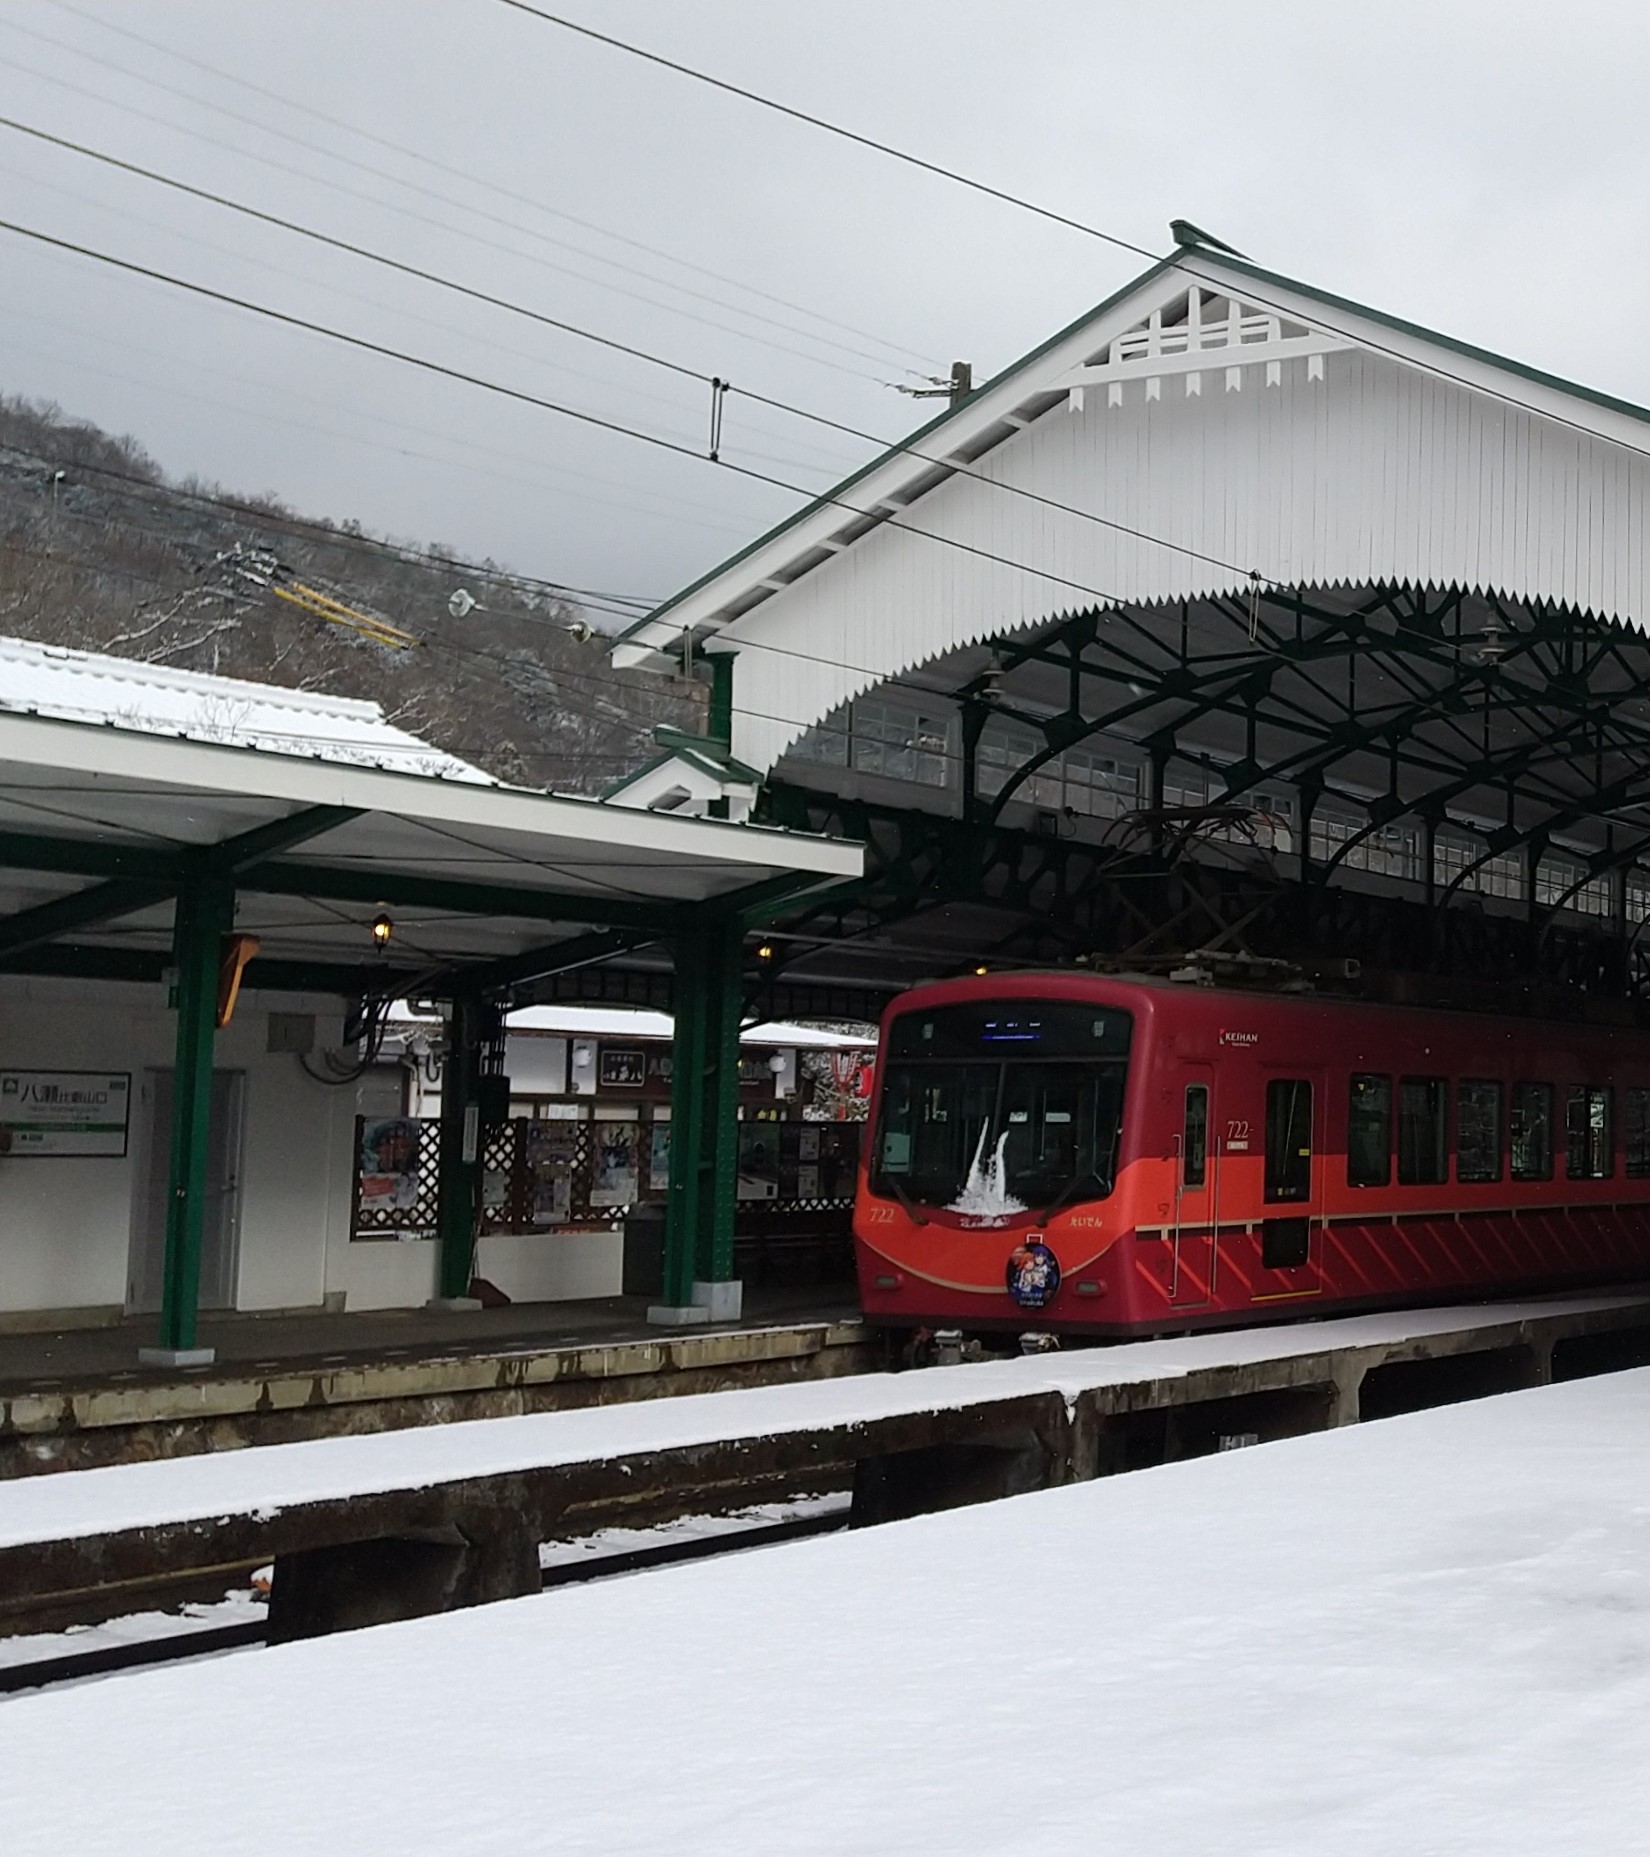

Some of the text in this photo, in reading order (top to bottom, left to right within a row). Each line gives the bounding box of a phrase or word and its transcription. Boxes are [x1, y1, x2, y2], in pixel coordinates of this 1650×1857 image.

[1225, 1032, 1258, 1043] KEIHAN
[870, 1207, 894, 1223] 722
[1070, 1216, 1103, 1228] えいでん
